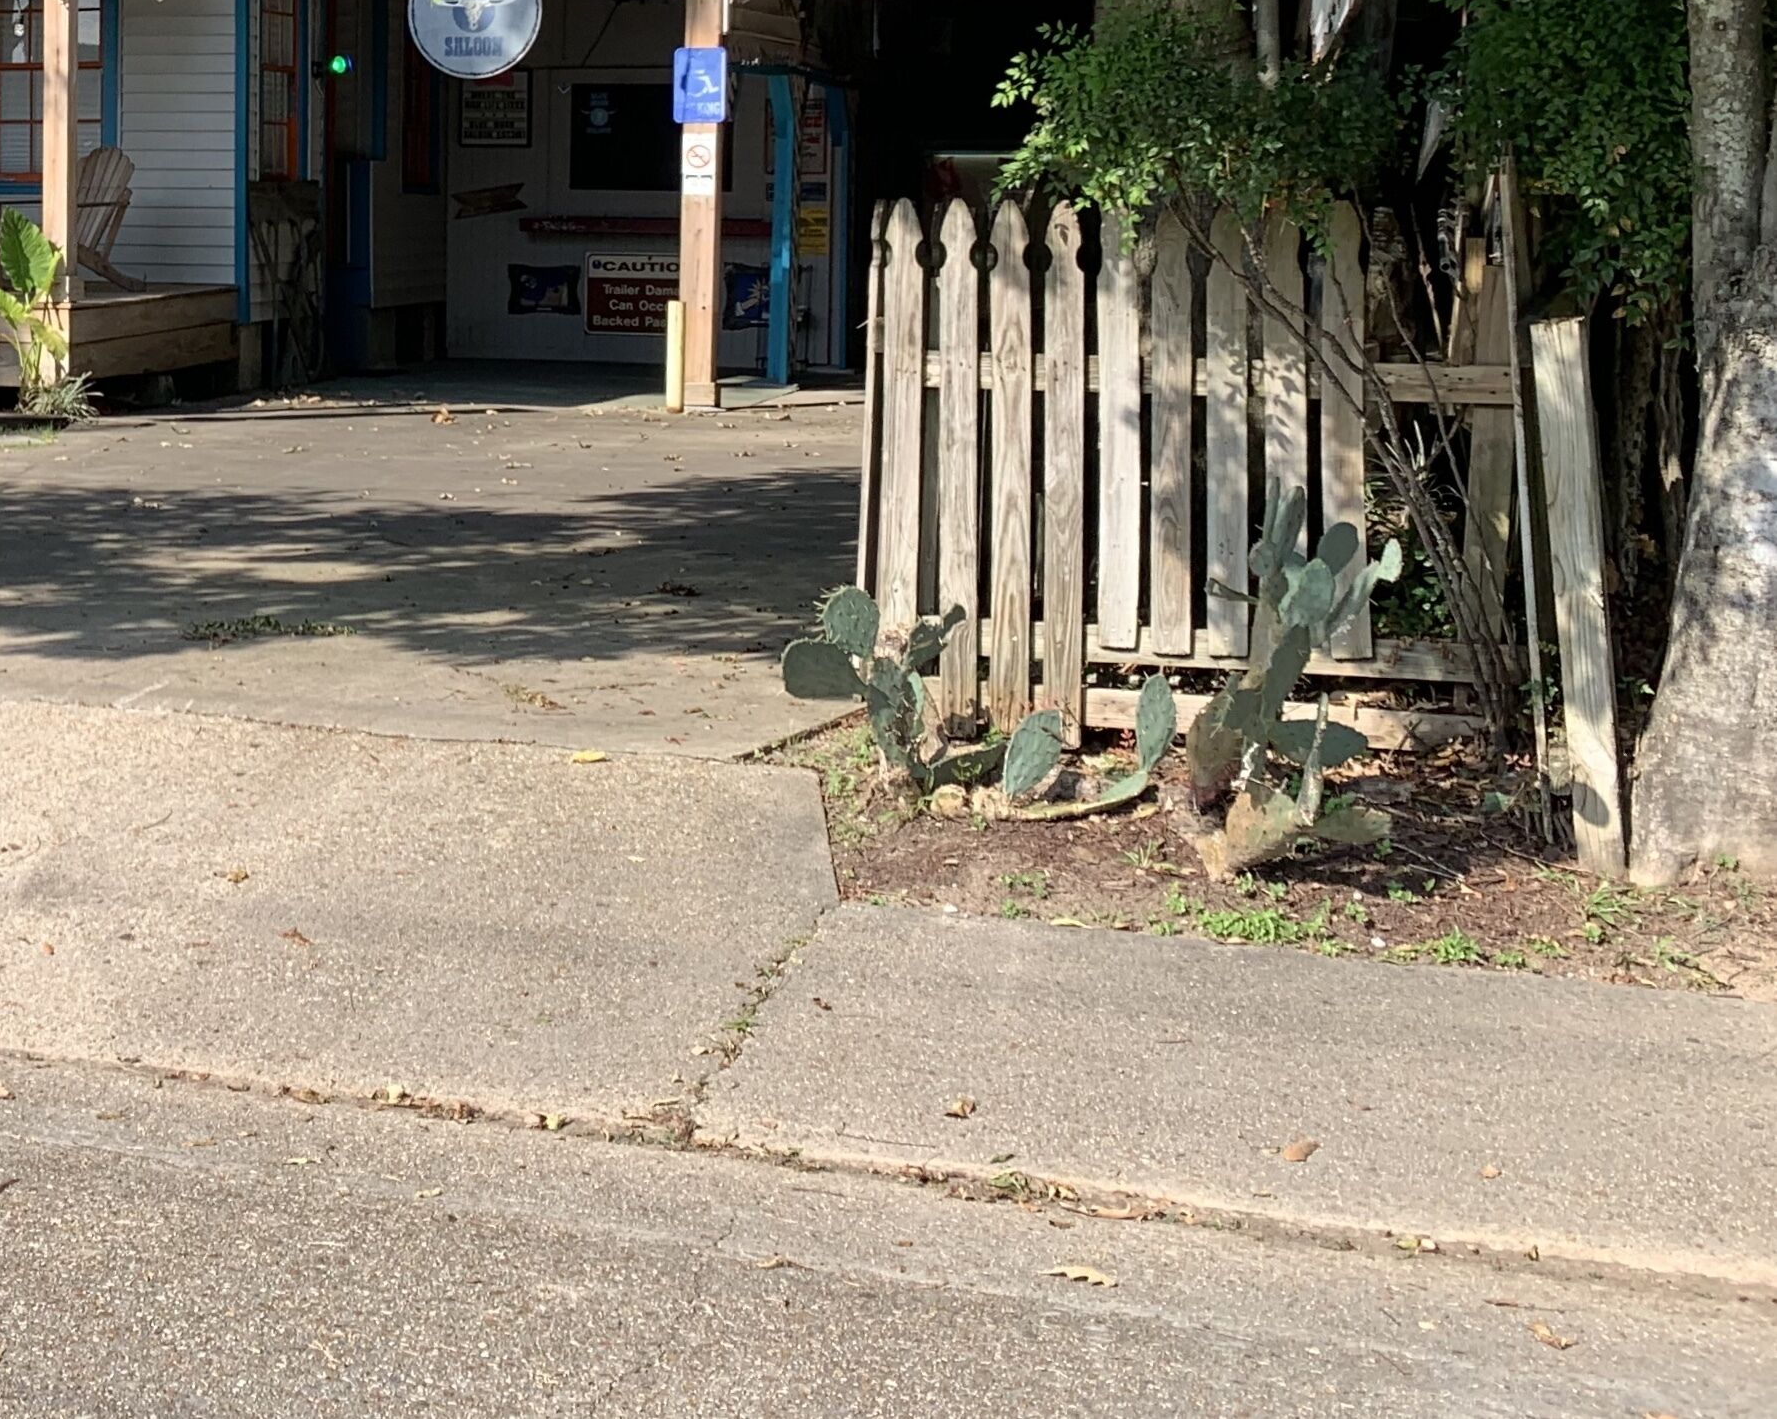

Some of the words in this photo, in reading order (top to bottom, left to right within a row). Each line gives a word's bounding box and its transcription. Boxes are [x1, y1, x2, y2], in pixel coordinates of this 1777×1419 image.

[443, 36, 504, 57] SALOON
[602, 261, 679, 273] CAUTIO
[602, 283, 640, 296] Trailer
[645, 284, 679, 297] Dama
[608, 299, 634, 311] Can
[638, 300, 667, 312] Occ
[592, 315, 640, 328] Backed
